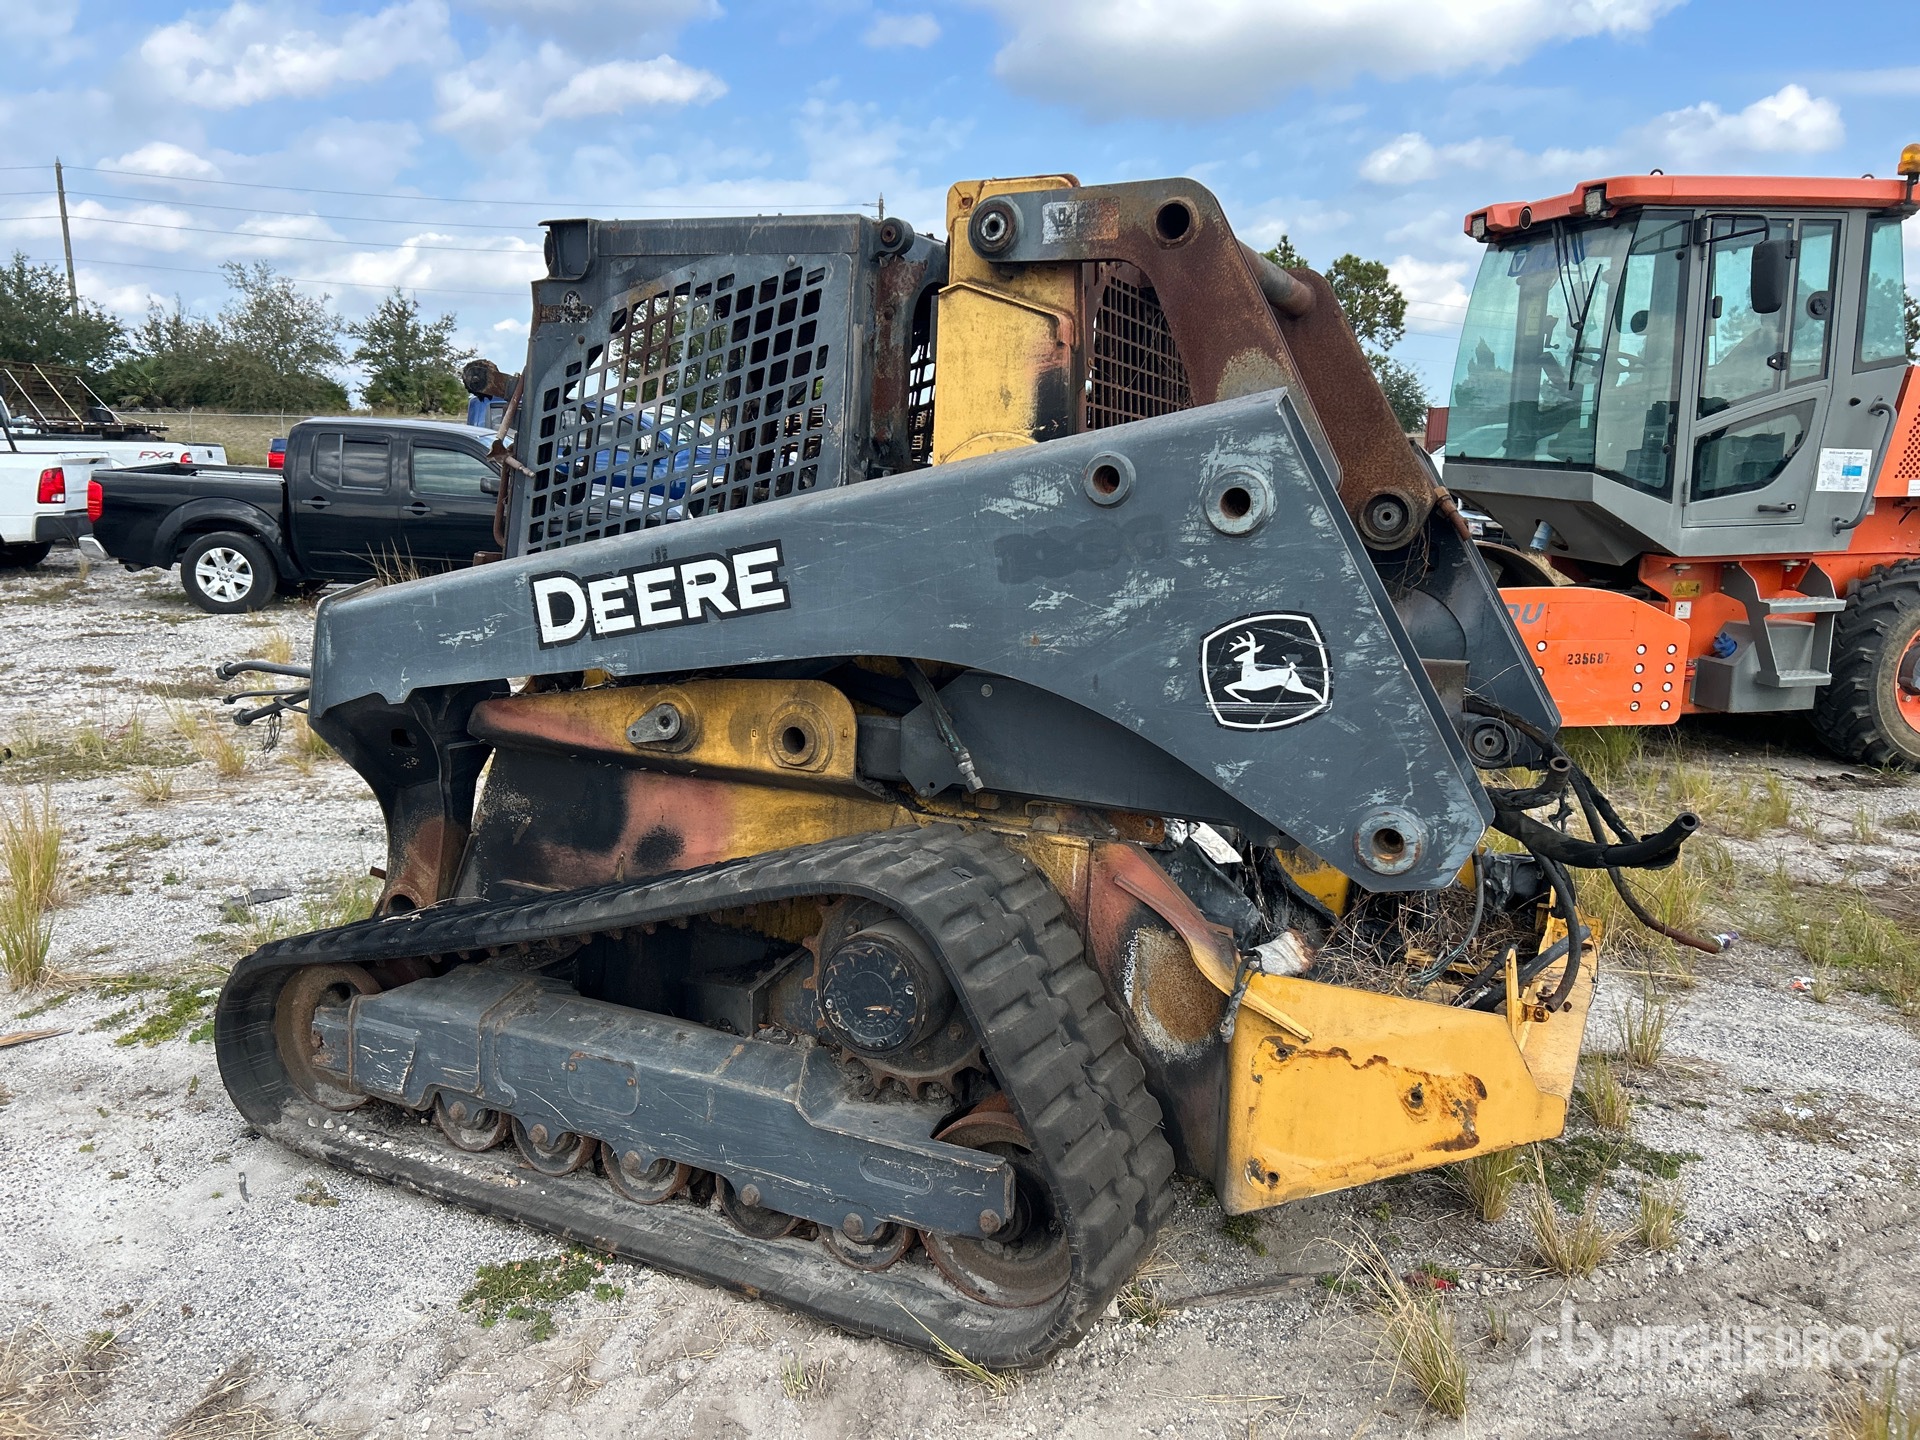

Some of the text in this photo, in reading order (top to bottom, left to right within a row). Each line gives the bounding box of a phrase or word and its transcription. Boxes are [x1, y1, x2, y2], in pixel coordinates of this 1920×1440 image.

[139, 450, 175, 459] FX4
[532, 546, 786, 644] DEERE
[1567, 652, 1610, 665] 235687
